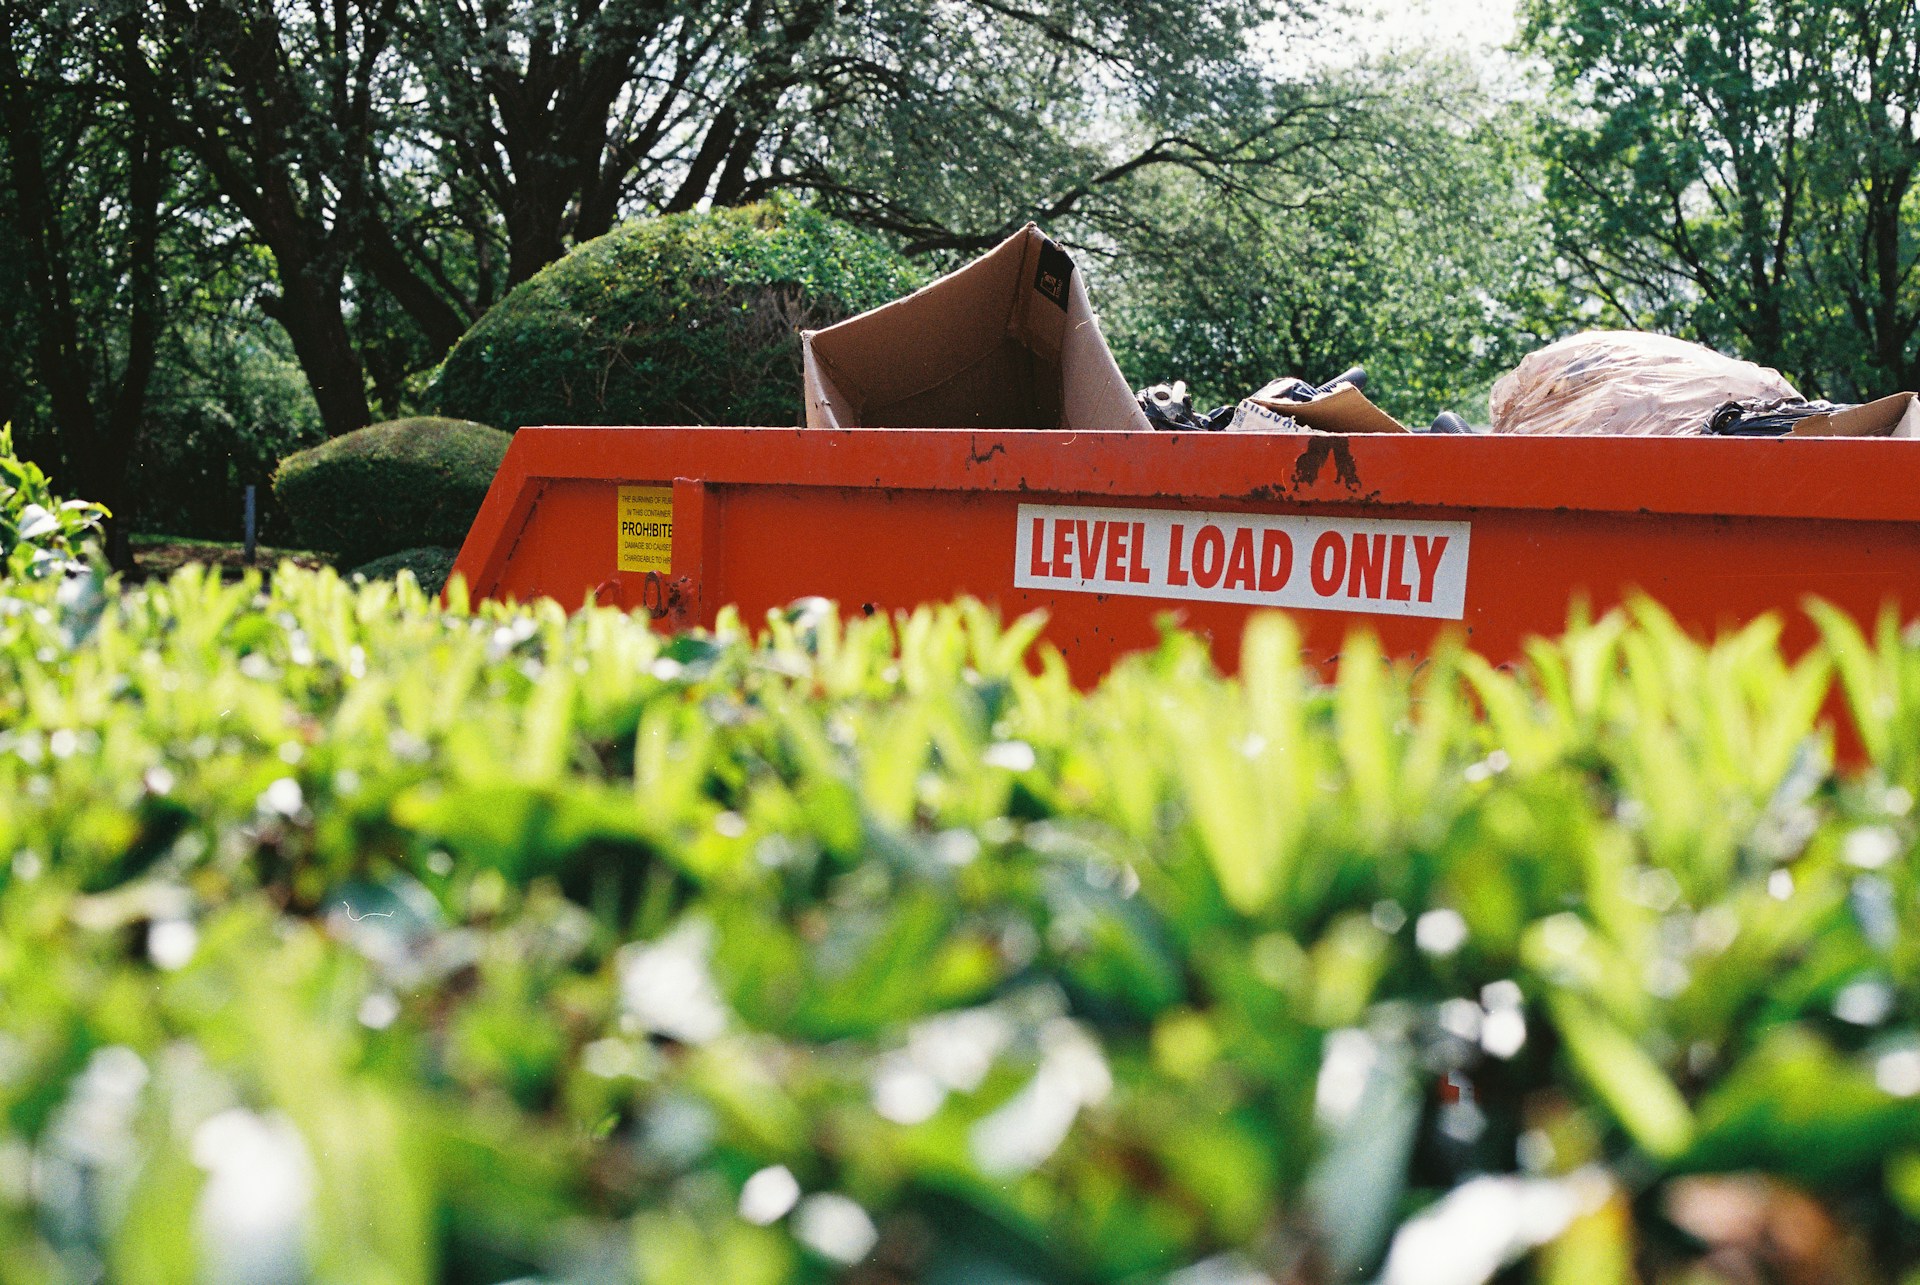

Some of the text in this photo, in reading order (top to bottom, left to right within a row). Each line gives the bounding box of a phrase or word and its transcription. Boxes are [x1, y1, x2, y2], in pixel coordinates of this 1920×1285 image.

[622, 495, 631, 503] THE
[654, 496, 661, 504] OF
[632, 509, 643, 517] THIS
[625, 541, 644, 550] DAMAGE
[645, 542, 653, 550] SO
[624, 554, 655, 563] CHARGEABLE
[655, 555, 662, 564] TO
[1030, 517, 1449, 602] LEVEL LOAD ONLY
